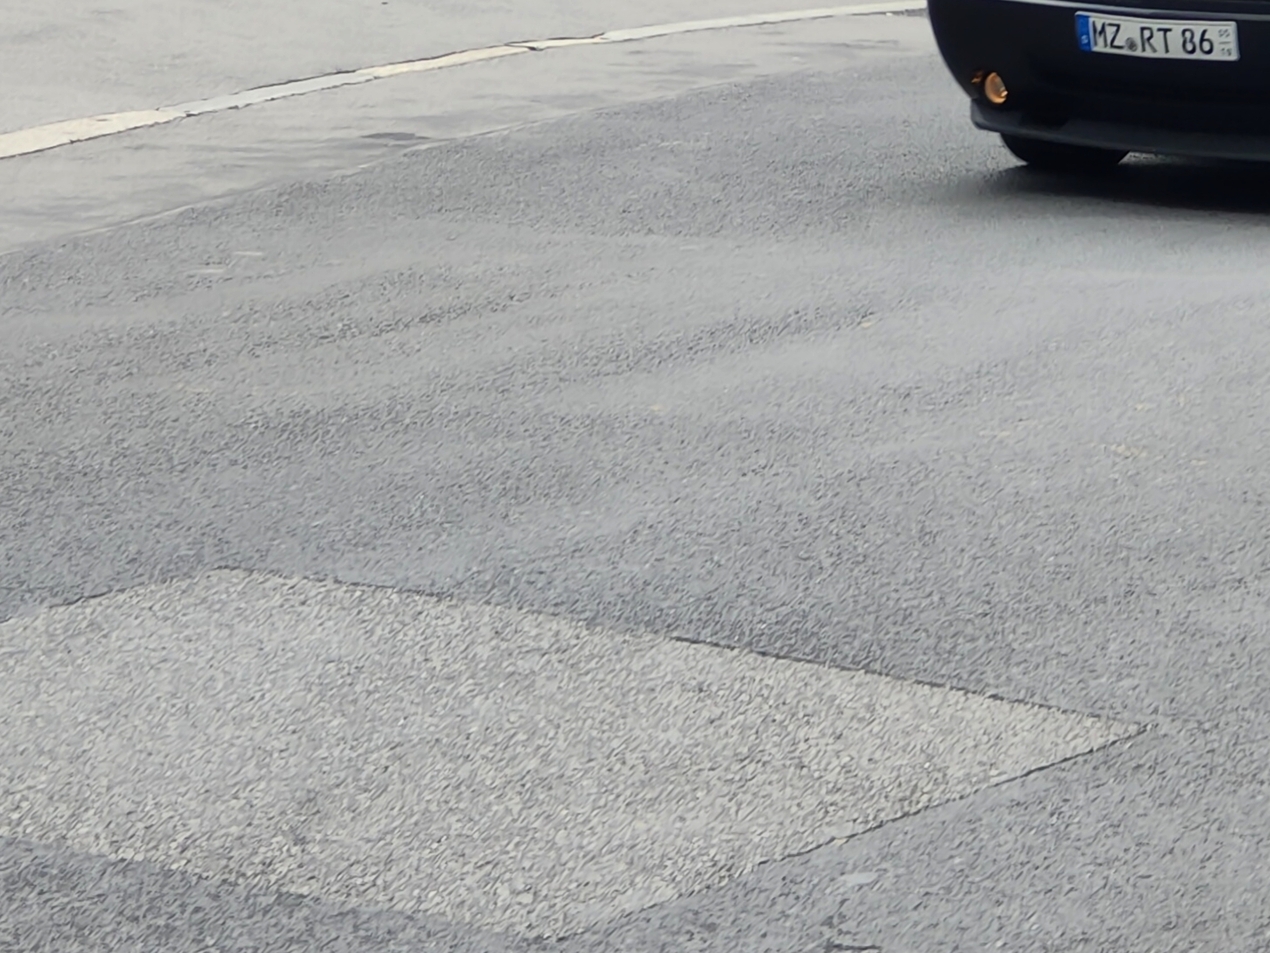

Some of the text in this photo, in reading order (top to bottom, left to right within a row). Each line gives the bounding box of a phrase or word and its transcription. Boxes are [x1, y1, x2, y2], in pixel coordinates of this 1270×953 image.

[1092, 20, 1125, 49] MZ
[1139, 26, 1172, 54] RT
[1181, 28, 1214, 55] 86
